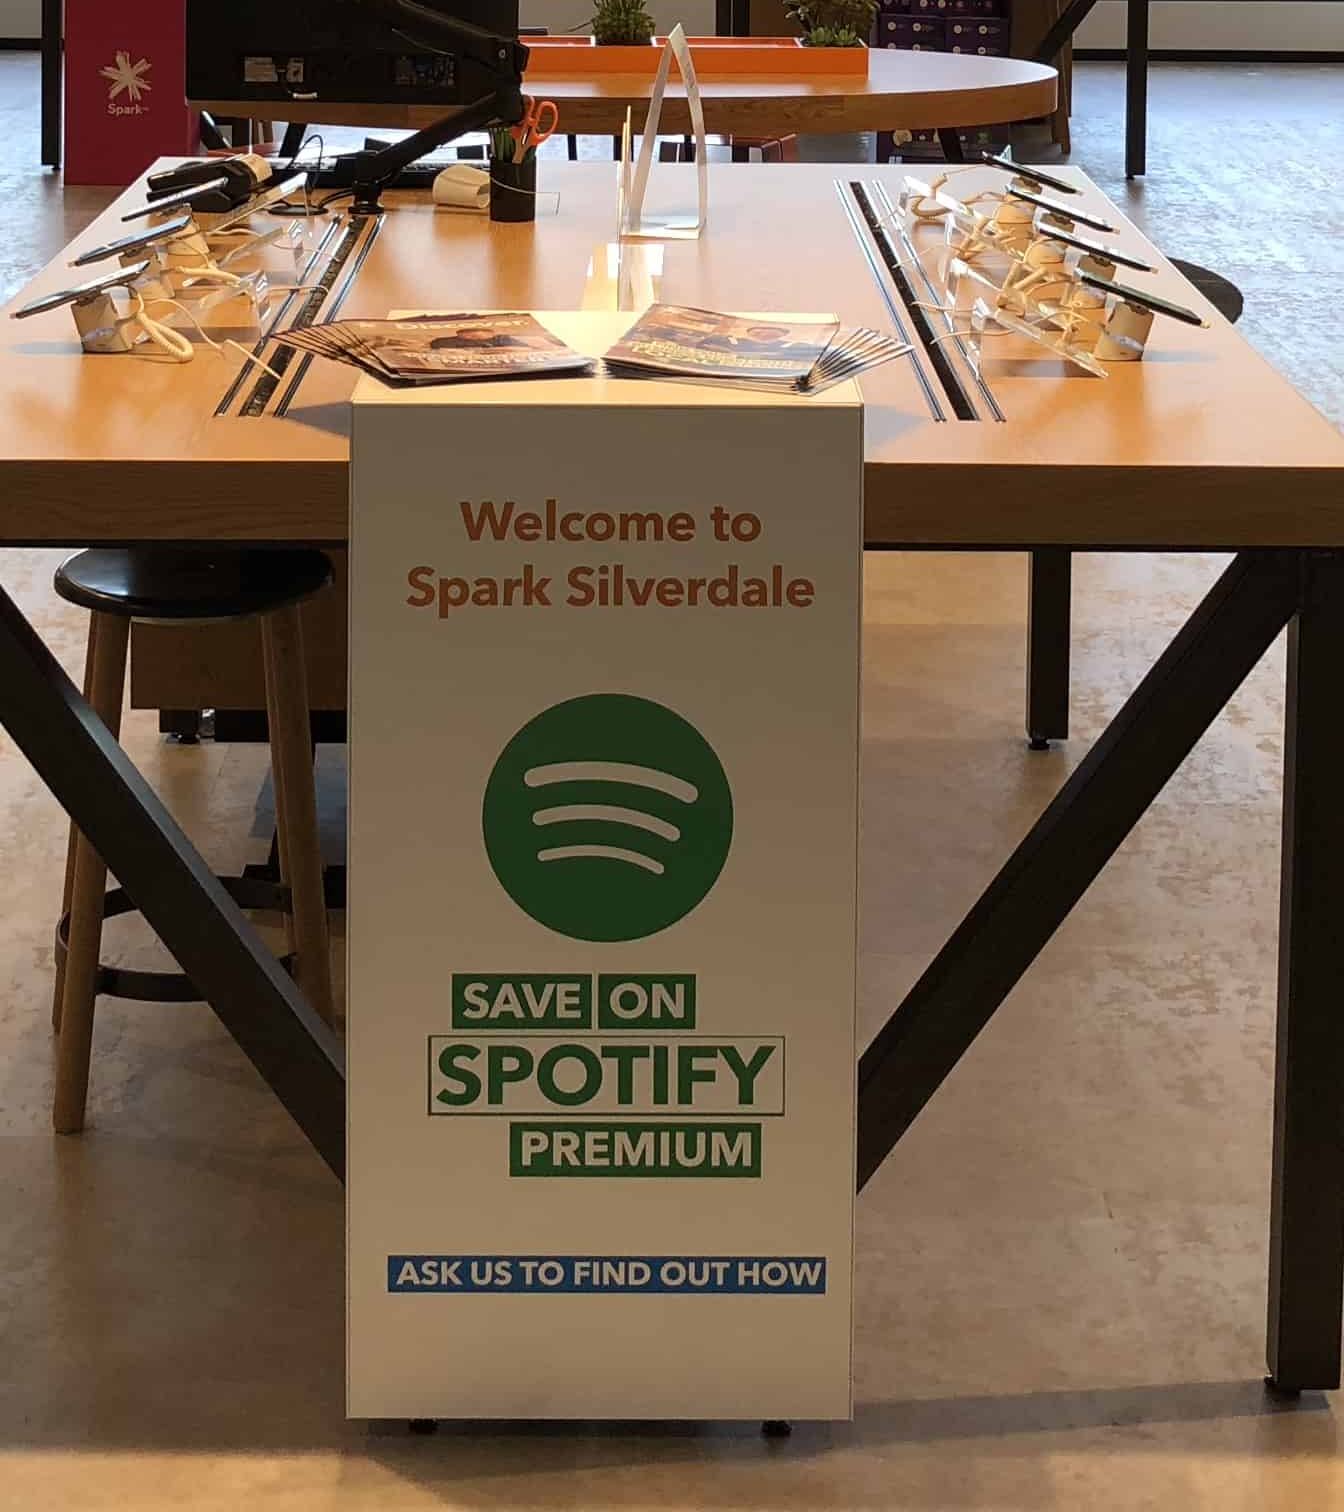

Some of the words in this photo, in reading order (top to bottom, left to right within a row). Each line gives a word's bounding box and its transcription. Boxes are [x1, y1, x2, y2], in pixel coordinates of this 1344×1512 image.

[107, 103, 144, 117] Spark
[459, 499, 695, 541] Welcome
[711, 506, 762, 541] to
[406, 564, 552, 619] Spark
[567, 564, 815, 607] Silverdale
[462, 982, 582, 1019] SAVE
[609, 982, 685, 1019] ON
[435, 1044, 776, 1107] SPOTIFY
[521, 1131, 752, 1168] PREMIUM
[396, 1261, 462, 1287] ASK
[471, 1261, 513, 1287] US
[519, 1261, 565, 1287] TO
[574, 1261, 651, 1287] FIND
[660, 1261, 731, 1287] OUT
[737, 1261, 823, 1288] HOW
